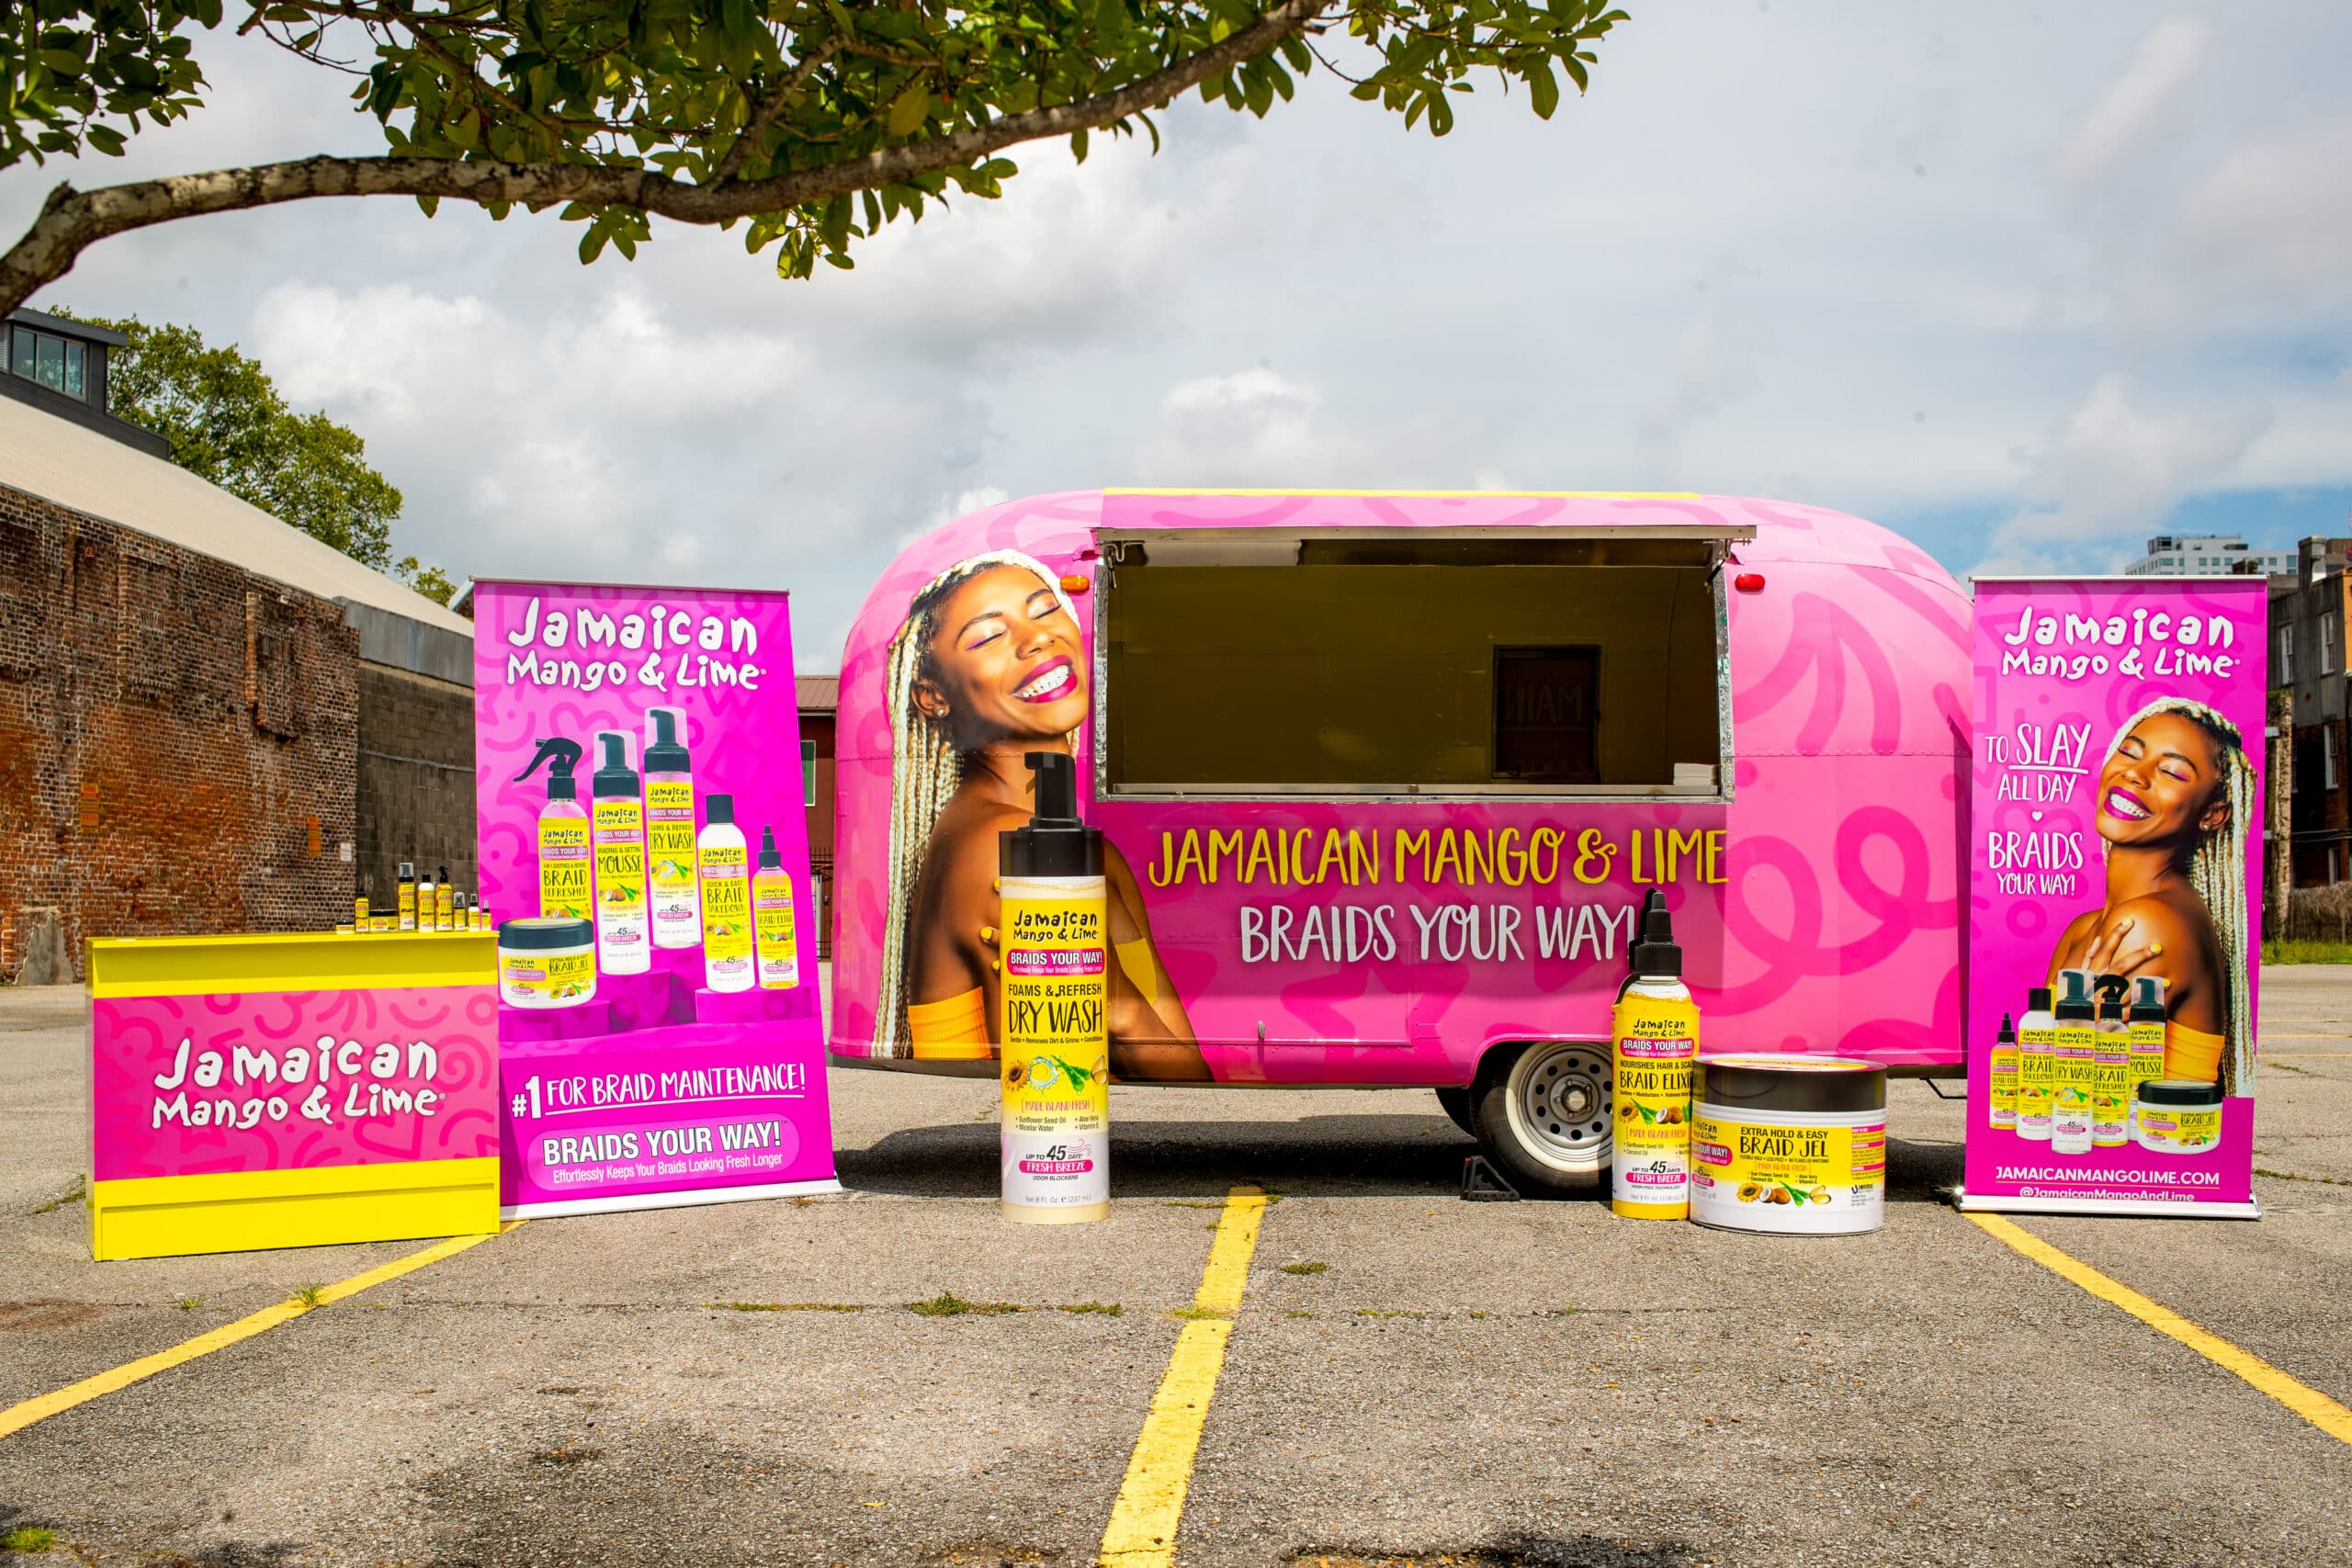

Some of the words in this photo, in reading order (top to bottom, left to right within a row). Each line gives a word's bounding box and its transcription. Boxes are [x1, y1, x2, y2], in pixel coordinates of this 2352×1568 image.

[508, 596, 757, 656] Jamaican
[2004, 605, 2233, 649] Jamaican
[507, 650, 627, 692] Mango
[638, 652, 668, 693] &
[2001, 647, 2109, 680] Mango
[2118, 647, 2145, 680] &
[1984, 735, 2009, 763] TO
[2016, 723, 2092, 769] SLAY
[1997, 773, 2031, 801] ALL
[2038, 774, 2077, 803] DAY
[1148, 828, 1378, 887] JAMAICAN
[1396, 828, 1566, 886] MANGO
[1573, 829, 1617, 885] &
[1631, 829, 1729, 885] LIME
[1988, 831, 2083, 870] BRAIDS
[598, 854, 641, 874] MOUSSE
[543, 870, 587, 886] BRAID
[1996, 873, 2037, 895] YOUR
[2040, 874, 2075, 897] WAY!
[707, 887, 744, 904] BRAID
[1013, 909, 1097, 927] Jamaican
[1013, 930, 1053, 942] Mango
[1057, 929, 1069, 942] &
[1072, 928, 1098, 940] Lime
[1241, 905, 1396, 963] BRAIDS
[1409, 904, 1524, 962] YOUR
[1535, 904, 1636, 962] WAY!
[548, 961, 576, 973] BRAID
[1011, 952, 1047, 964] BRAIDS
[1050, 953, 1080, 964] YOUR
[1082, 952, 1102, 964] WAY!
[1009, 985, 1041, 997] FOAMS
[1046, 986, 1054, 997] &
[1058, 983, 1102, 996] REFRESH
[1009, 1000, 1044, 1033] DRY
[1047, 999, 1102, 1033] WASH
[1634, 1019, 1685, 1029] Jamaican
[1623, 1039, 1652, 1050] BRAIDS
[1654, 1041, 1676, 1050] YOUR
[154, 1035, 437, 1089] Jamaican
[1621, 1059, 1655, 1069] NOURISHES
[1620, 1070, 1658, 1089] BRAID
[512, 1076, 542, 1118] #1
[547, 1077, 587, 1106] FOR
[593, 1073, 655, 1104] BRAID
[661, 1063, 806, 1099] MAINTENANCE!
[153, 1091, 289, 1129] Mango
[300, 1085, 334, 1124] &
[1025, 1100, 1043, 1111] MADE
[1046, 1100, 1069, 1111] ISLAND
[1071, 1100, 1091, 1111] FRESH
[1740, 1126, 1769, 1136] EXTRA
[1770, 1129, 1794, 1138] HOLD
[1796, 1130, 1804, 1138] &
[1806, 1131, 1828, 1139] EASY
[543, 1132, 639, 1166] BRAIDS
[645, 1126, 713, 1156] YOUR
[718, 1121, 782, 1150] WAY!
[1046, 1145, 1068, 1161] 45
[1712, 1146, 1727, 1157] WAY!
[1740, 1135, 1794, 1156] BRAID
[1799, 1140, 1829, 1157] JEL
[553, 1167, 604, 1184] Effortlessly
[606, 1164, 634, 1179] Keeps
[637, 1162, 656, 1177] Your
[658, 1160, 687, 1176] Braids
[689, 1157, 724, 1174] Looking
[726, 1155, 751, 1169] Fresh
[752, 1153, 783, 1168] Longer
[1027, 1162, 1054, 1172] FRESH
[1055, 1161, 1086, 1172] BREEZE
[1649, 1160, 1668, 1174] 45
[1996, 1166, 2220, 1185] JAMAICANMANGOLIME.COM
[1633, 1174, 1656, 1183] FRESH
[1657, 1174, 1681, 1183] BREEZE
[2019, 1186, 2195, 1202] @JamaicanMangoAndLime
